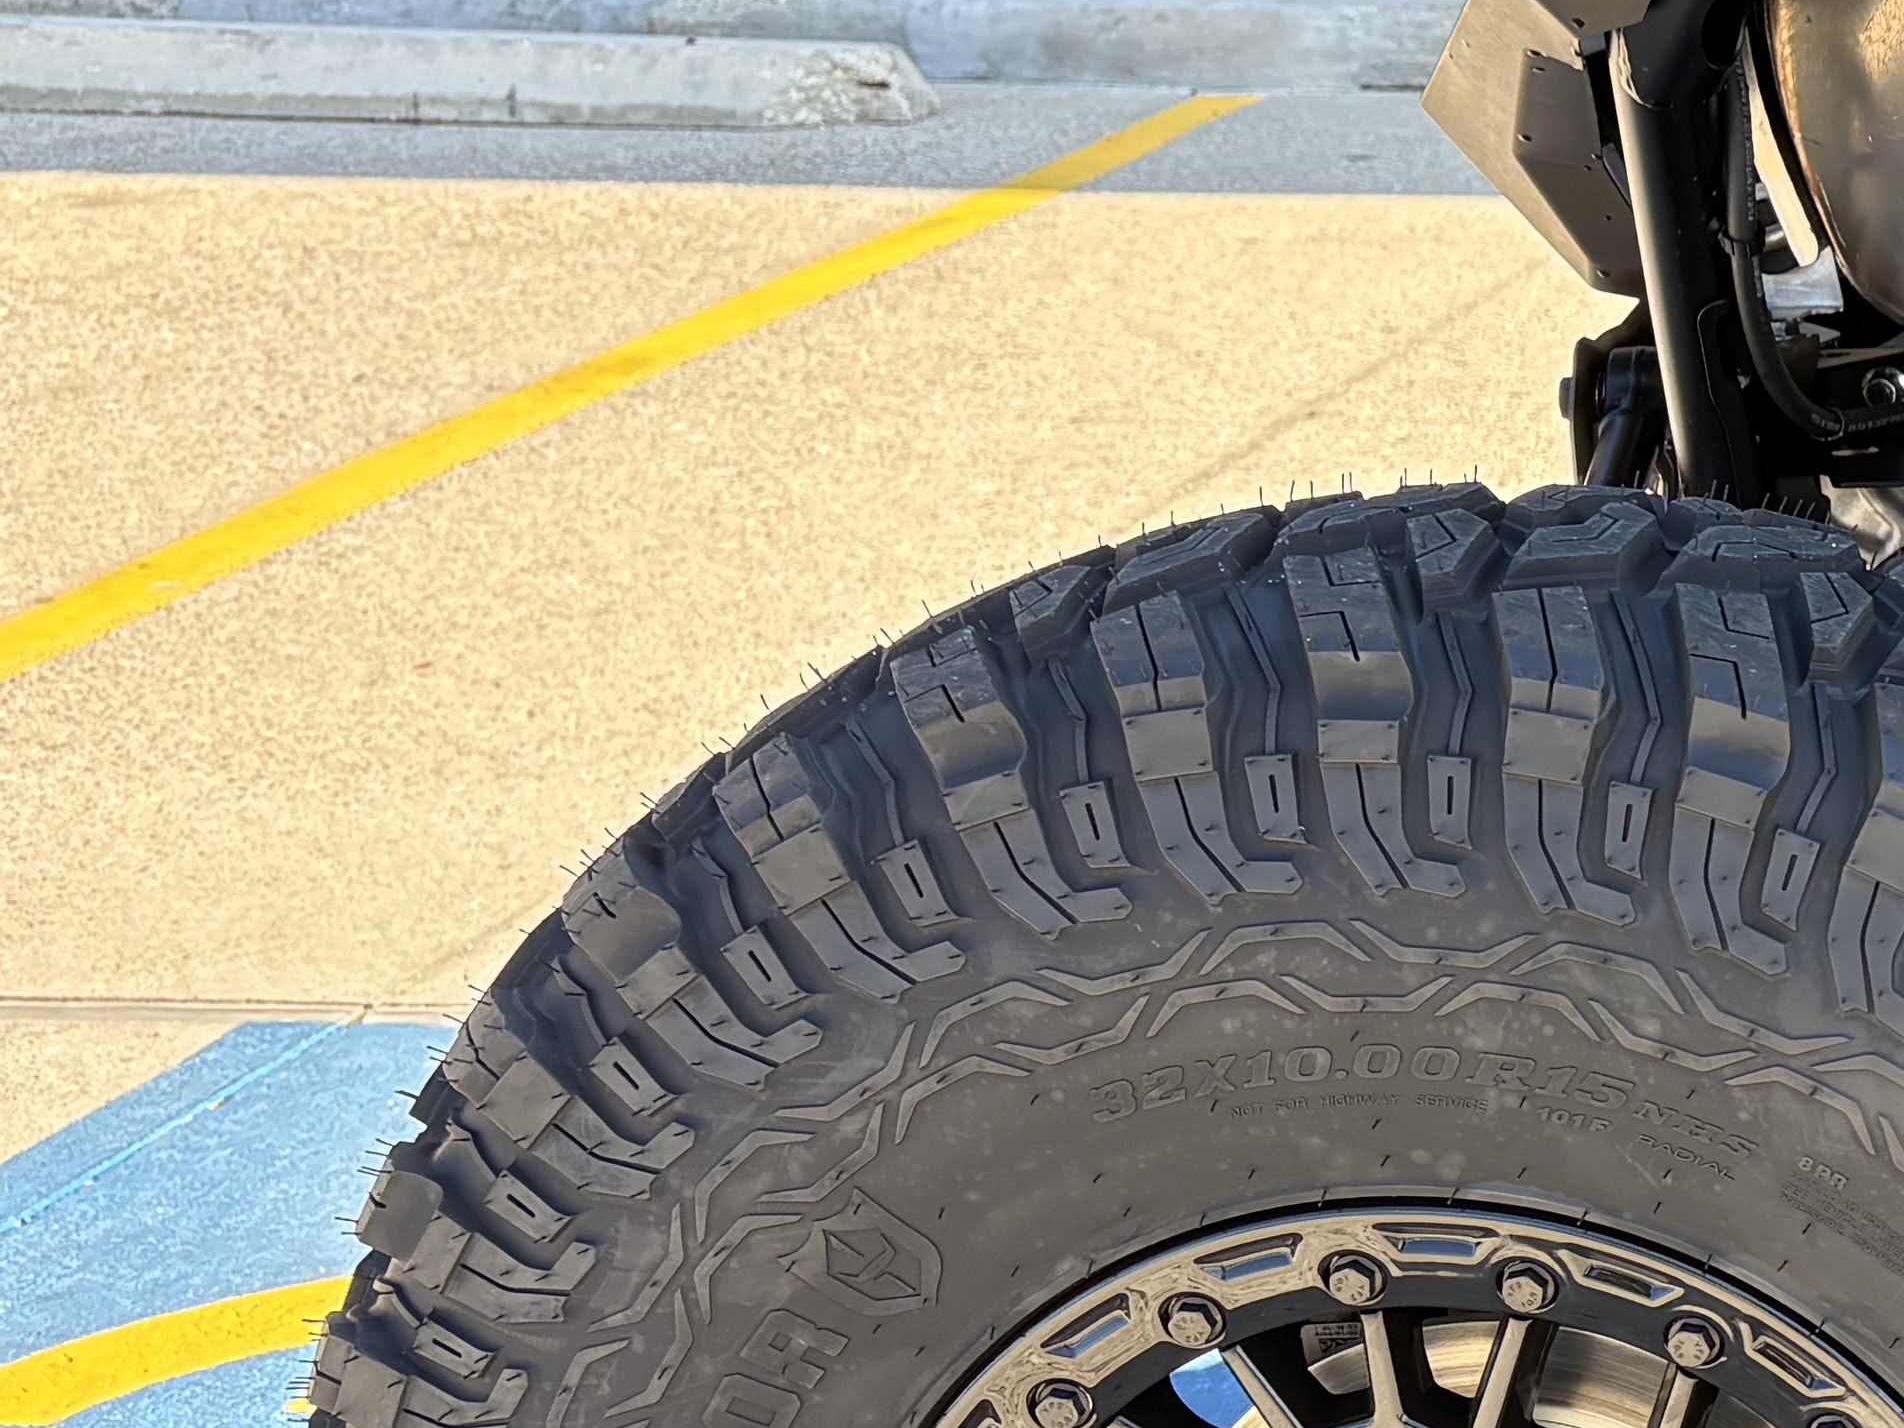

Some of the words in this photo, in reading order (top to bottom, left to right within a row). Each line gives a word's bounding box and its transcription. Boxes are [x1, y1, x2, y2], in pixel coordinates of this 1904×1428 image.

[1228, 1103, 1265, 1120] NOT
[1274, 1098, 1309, 1114] FOR
[1320, 1094, 1400, 1110] HIGHWAY
[1414, 1093, 1490, 1113] SERVICE
[1632, 1100, 1760, 1159] NHS
[1635, 1132, 1736, 1183] RADIAL
